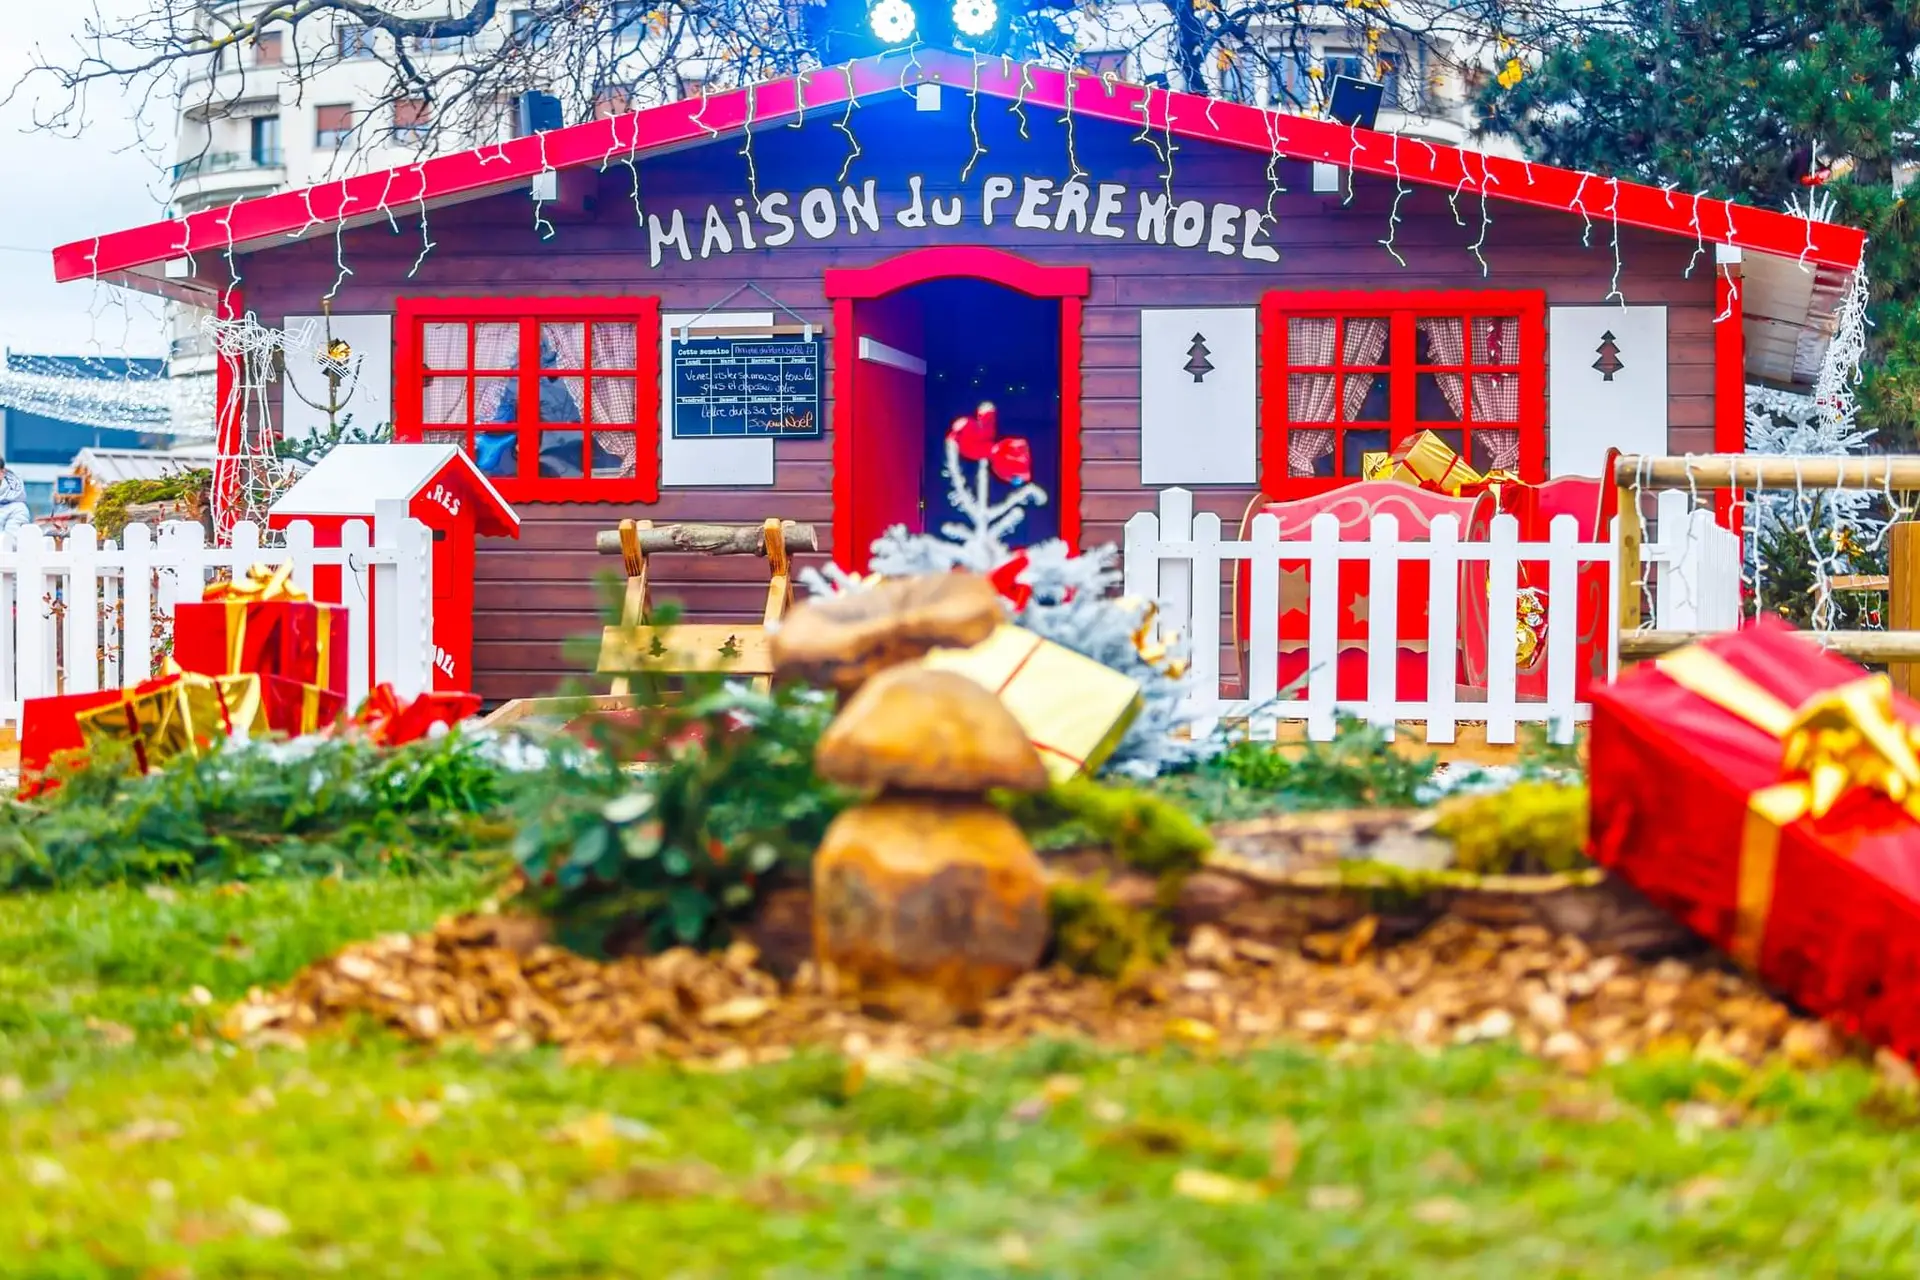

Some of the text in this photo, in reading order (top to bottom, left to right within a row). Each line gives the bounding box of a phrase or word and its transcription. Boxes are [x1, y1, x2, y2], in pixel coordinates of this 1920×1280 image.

[897, 175, 963, 227] du
[983, 176, 1127, 239] PERE
[1136, 190, 1280, 263] NOEL
